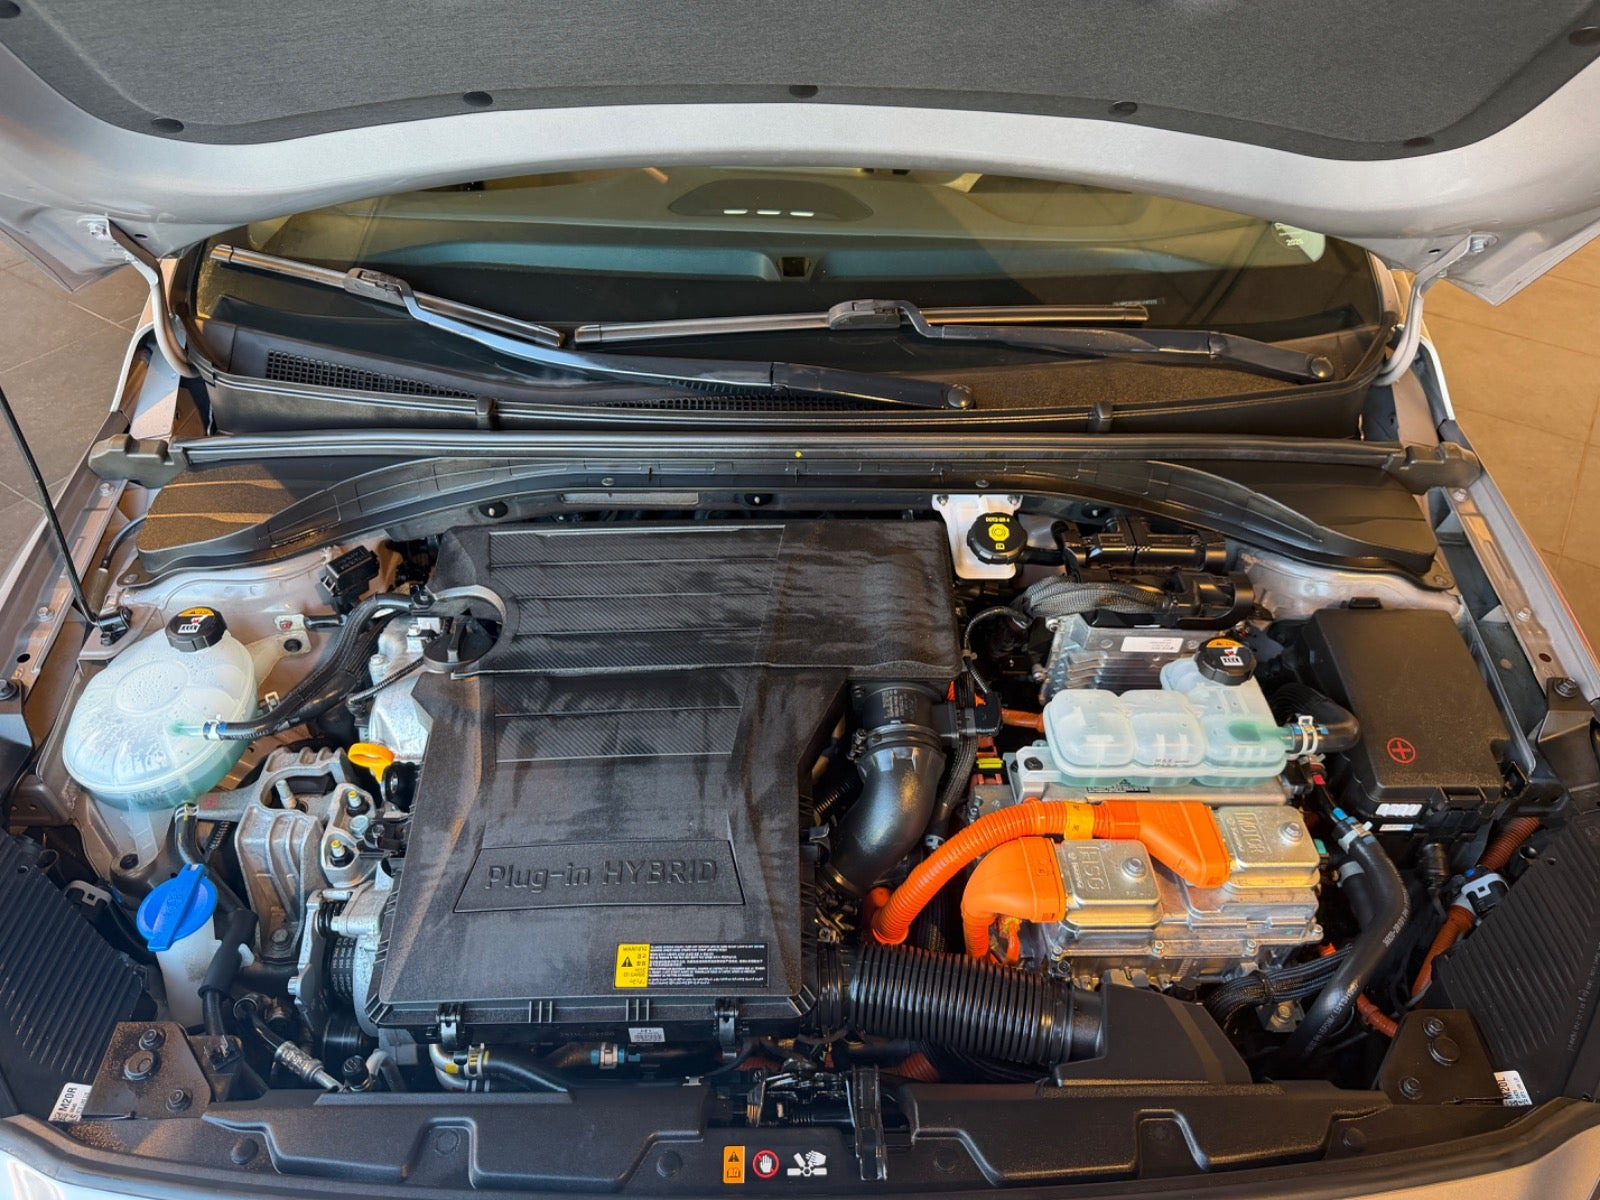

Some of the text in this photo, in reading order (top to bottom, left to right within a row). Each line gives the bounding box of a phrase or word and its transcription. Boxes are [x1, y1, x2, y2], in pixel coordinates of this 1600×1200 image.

[484, 858, 719, 894] Plug-in HYBRID
[1079, 850, 1105, 890] HSG
[58, 1087, 78, 1112] M20R
